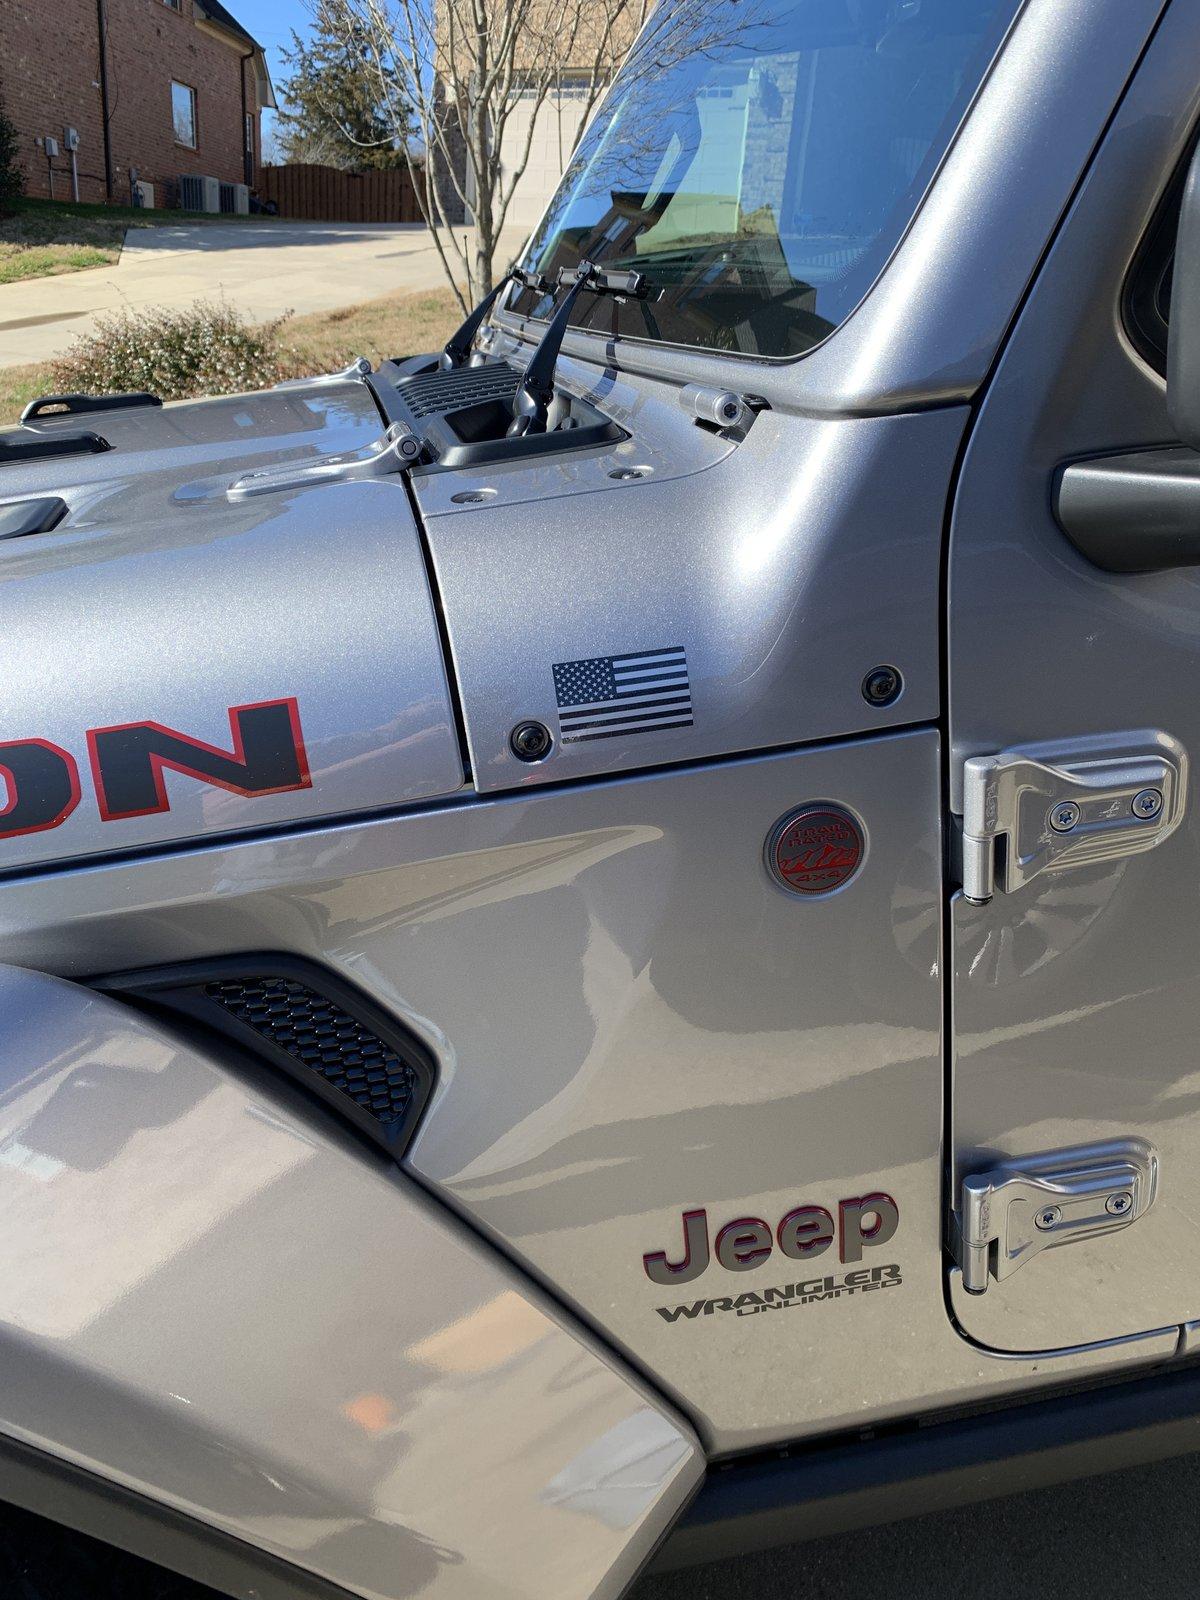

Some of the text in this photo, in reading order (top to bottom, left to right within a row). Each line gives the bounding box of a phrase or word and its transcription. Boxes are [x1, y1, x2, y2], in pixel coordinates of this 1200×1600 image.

[643, 1192, 899, 1286] Jeep
[655, 1263, 902, 1323] WRANGLER
[736, 1277, 903, 1317] UNLIMITED
